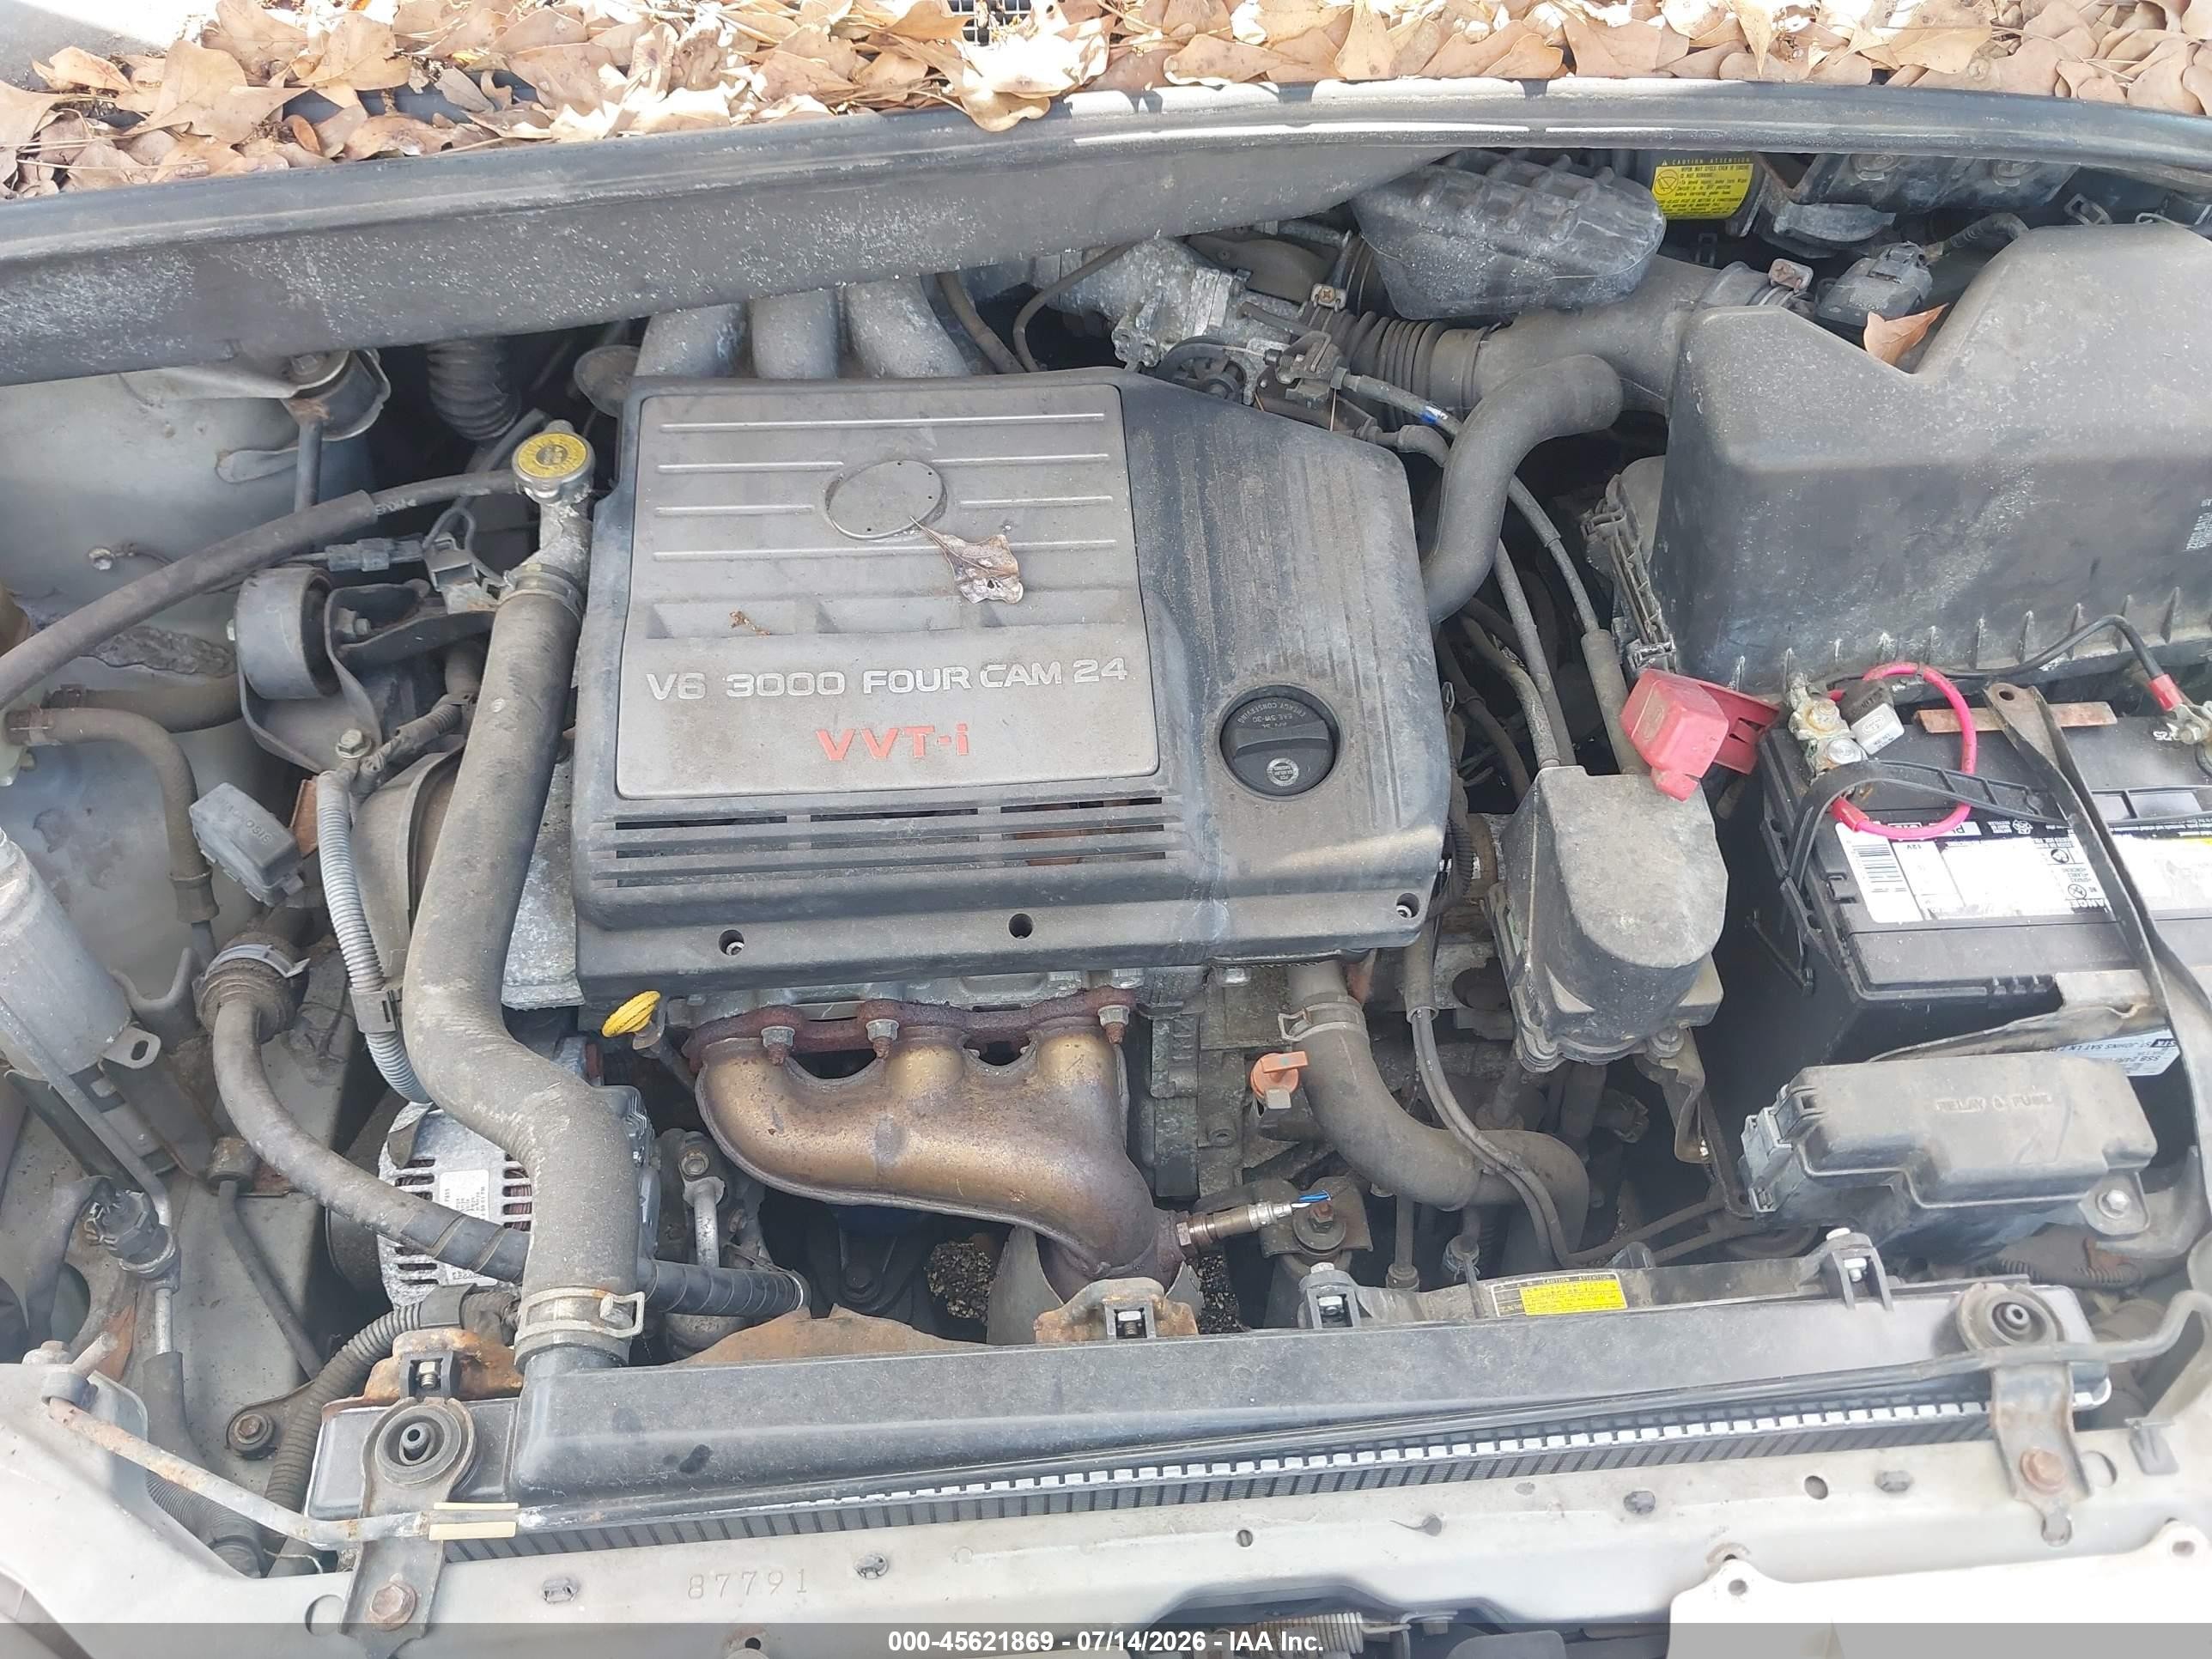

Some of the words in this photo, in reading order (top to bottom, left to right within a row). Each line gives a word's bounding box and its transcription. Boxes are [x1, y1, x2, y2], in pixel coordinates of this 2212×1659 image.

[646, 672, 706, 701] V6
[725, 671, 845, 697] 3000
[862, 665, 971, 694] FOUR
[979, 661, 1062, 689] CAM
[1073, 658, 1128, 682] 24
[1237, 702, 1277, 723] CONSERVING
[815, 723, 970, 761] VVT-i
[688, 1569, 807, 1599] 87791
